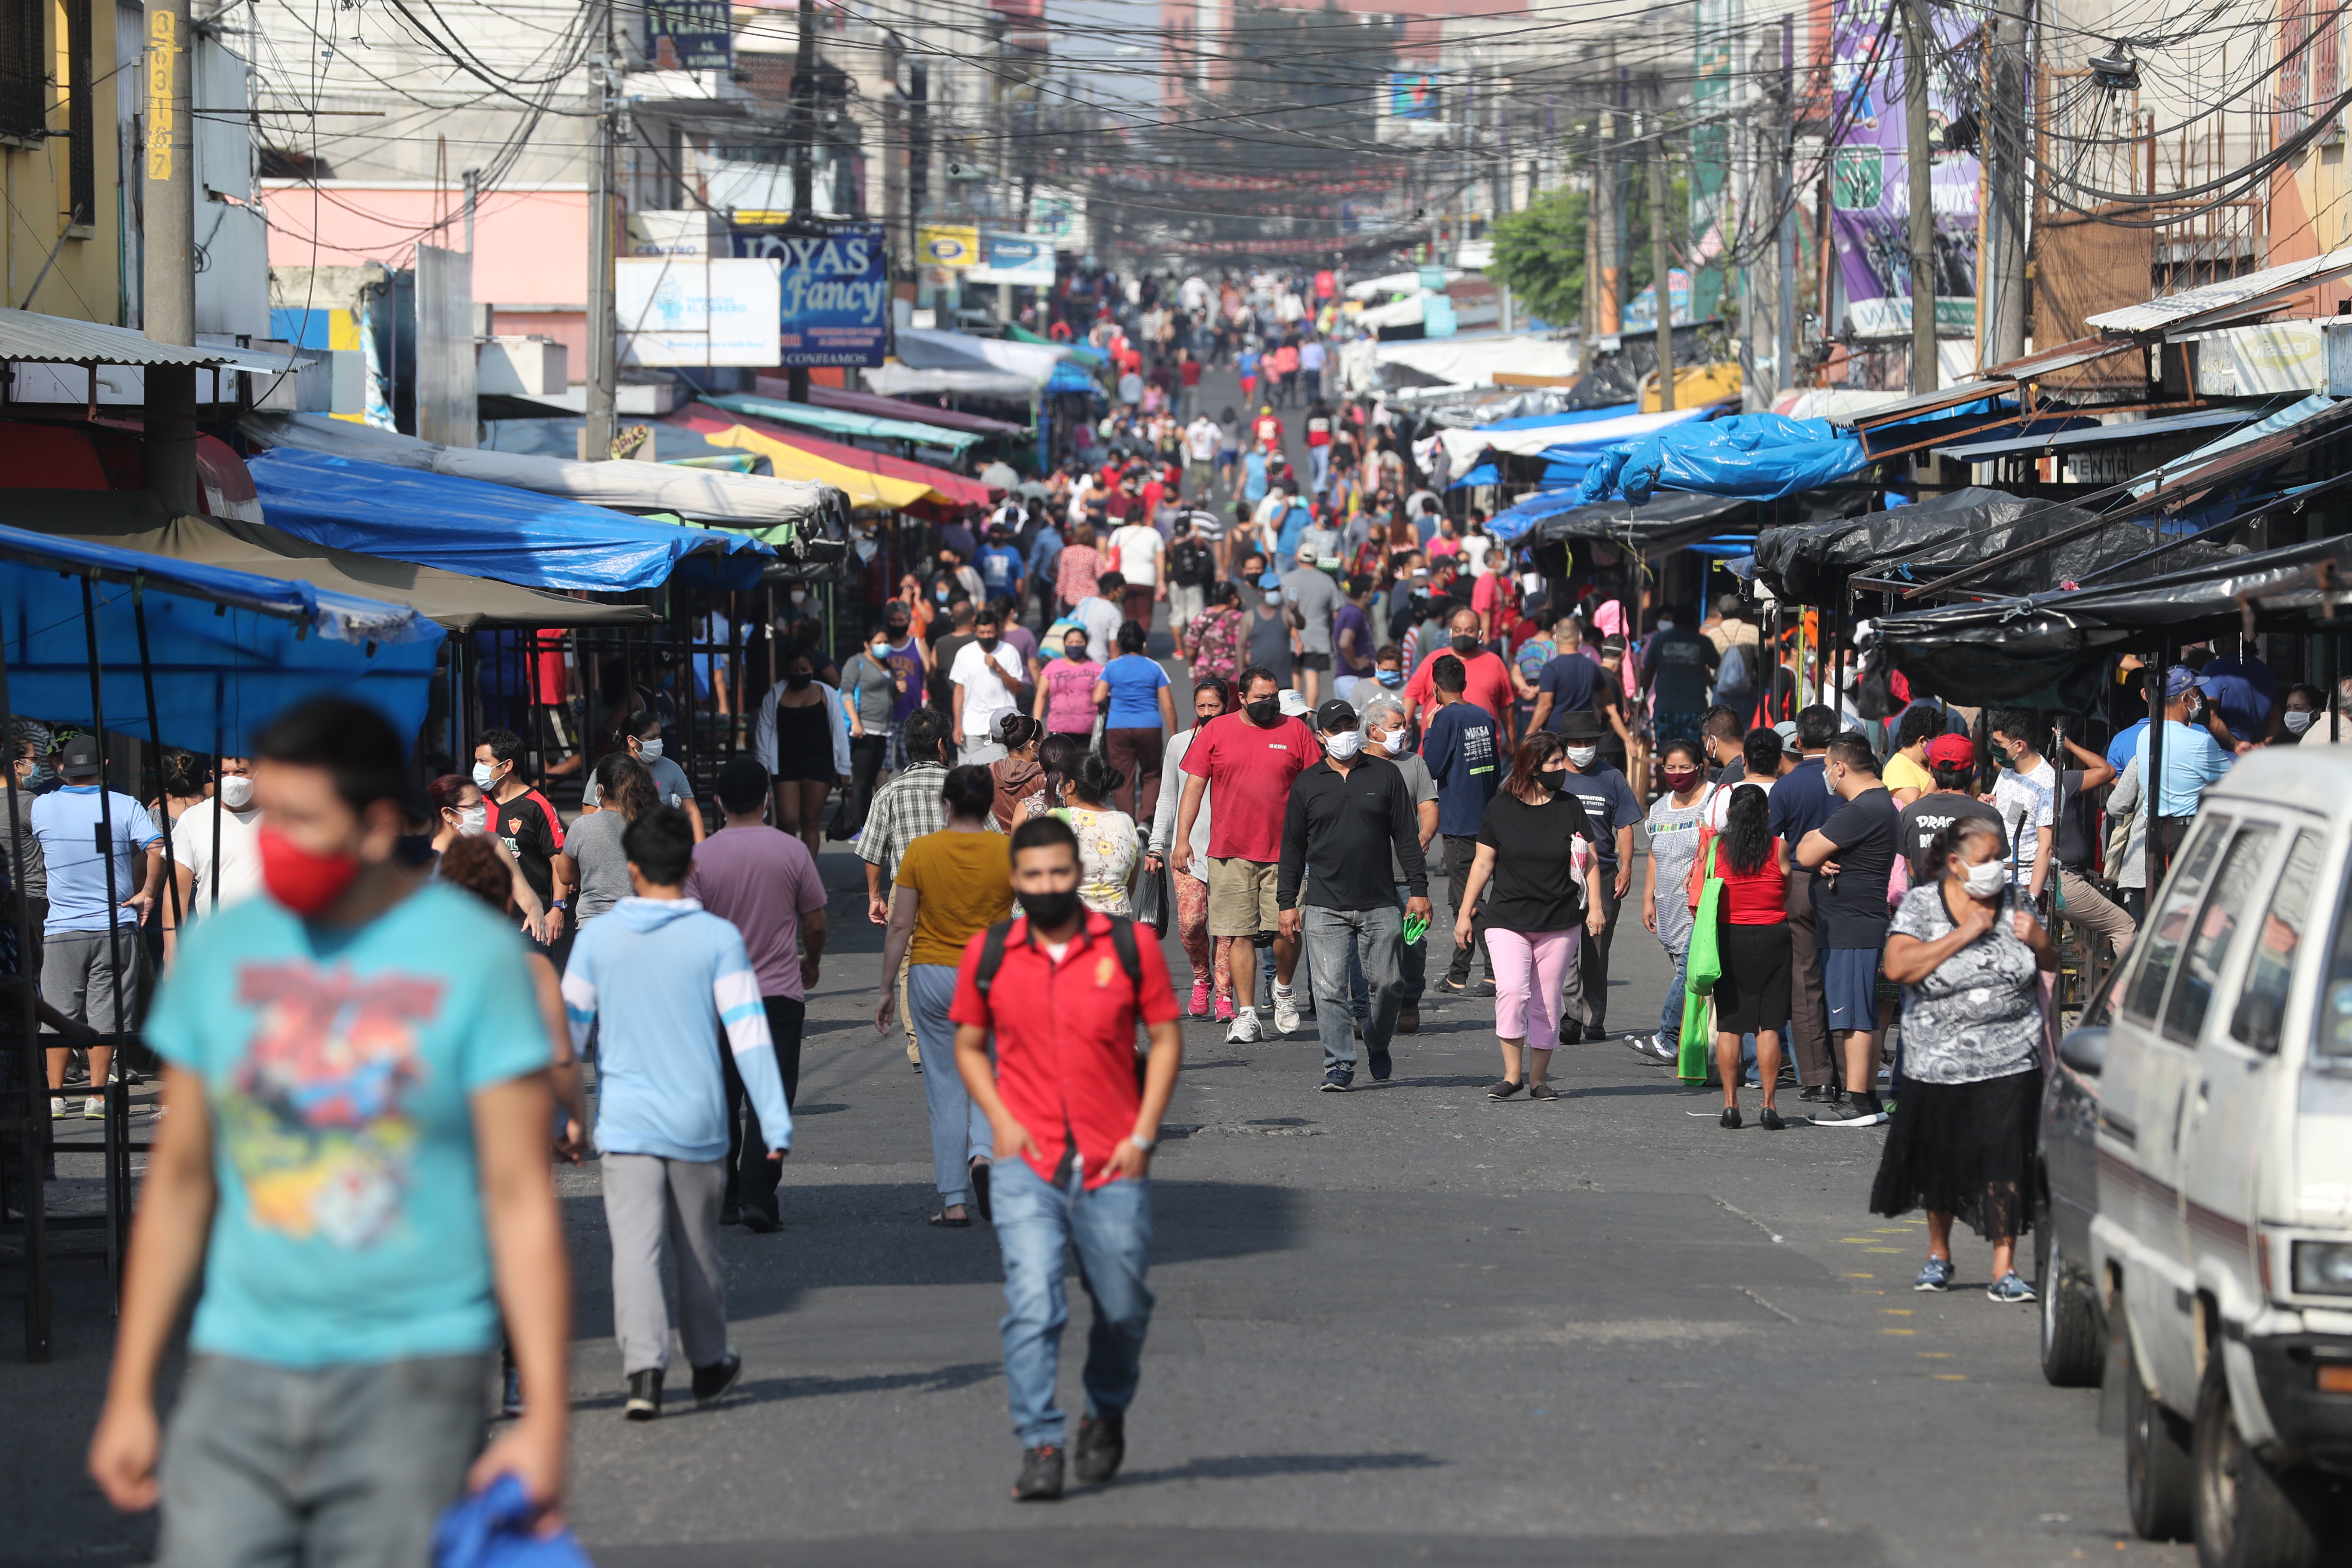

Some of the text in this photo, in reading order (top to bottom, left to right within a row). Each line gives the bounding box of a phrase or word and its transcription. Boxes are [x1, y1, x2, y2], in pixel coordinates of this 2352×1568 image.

[783, 274, 881, 325] Fancy
[2246, 339, 2312, 358] Maggi
[787, 352, 868, 364] CONFIAMOS
[2068, 459, 2139, 475] DENTAL
